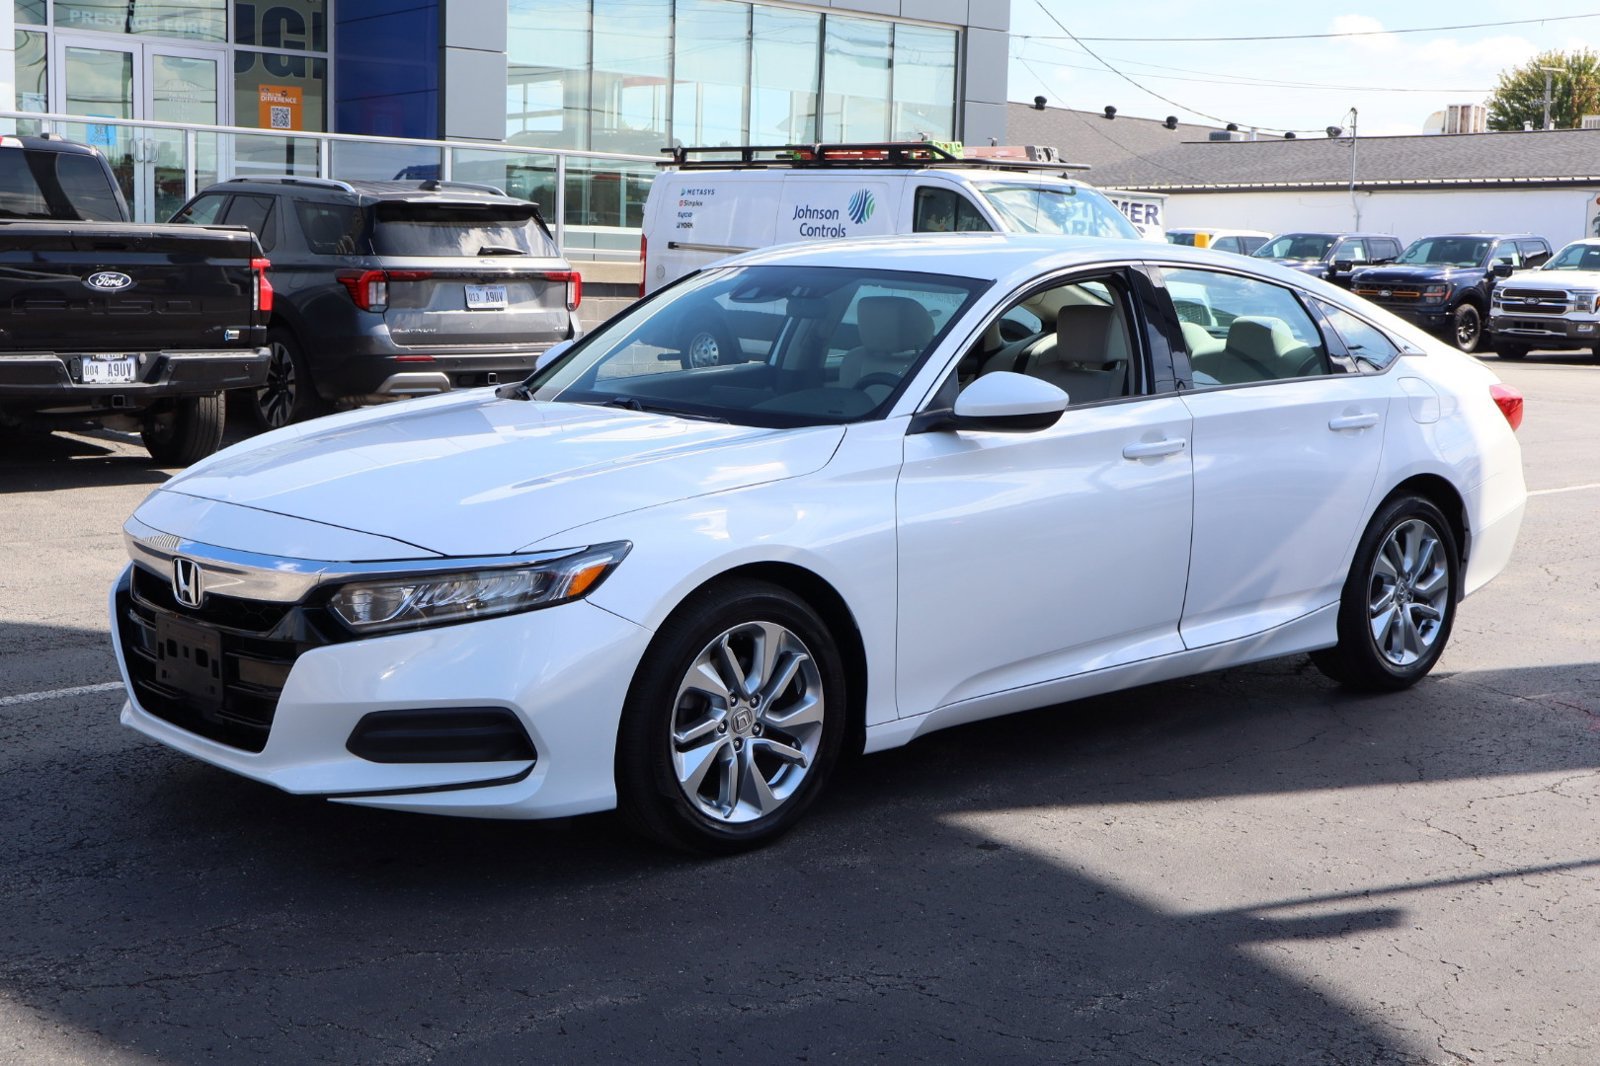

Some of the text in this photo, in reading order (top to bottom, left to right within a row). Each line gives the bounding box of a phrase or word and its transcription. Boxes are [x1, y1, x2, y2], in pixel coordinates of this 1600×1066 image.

[793, 205, 840, 220] Johnson
[800, 222, 846, 238] Controls
[95, 273, 124, 287] Ford
[84, 364, 99, 376] 004
